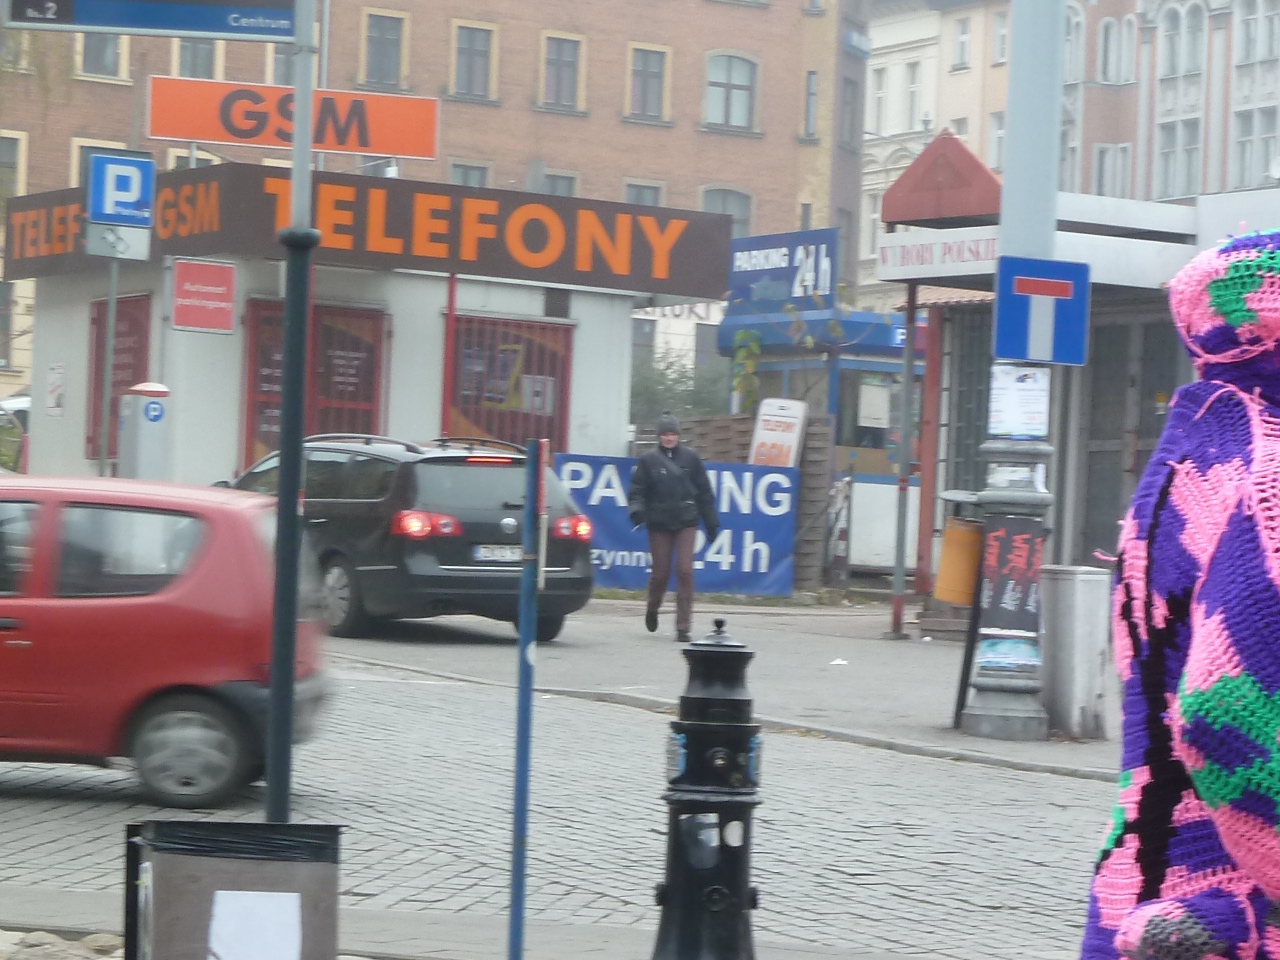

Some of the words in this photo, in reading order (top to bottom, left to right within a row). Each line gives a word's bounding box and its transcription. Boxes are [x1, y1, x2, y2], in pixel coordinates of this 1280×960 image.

[228, 13, 292, 29] Centrum
[219, 88, 370, 148] GSM
[11, 203, 88, 260] TELEF
[155, 181, 221, 240] GSM
[264, 177, 690, 280] TELEFONY
[733, 247, 792, 272] PARKING
[560, 460, 793, 517] PANG
